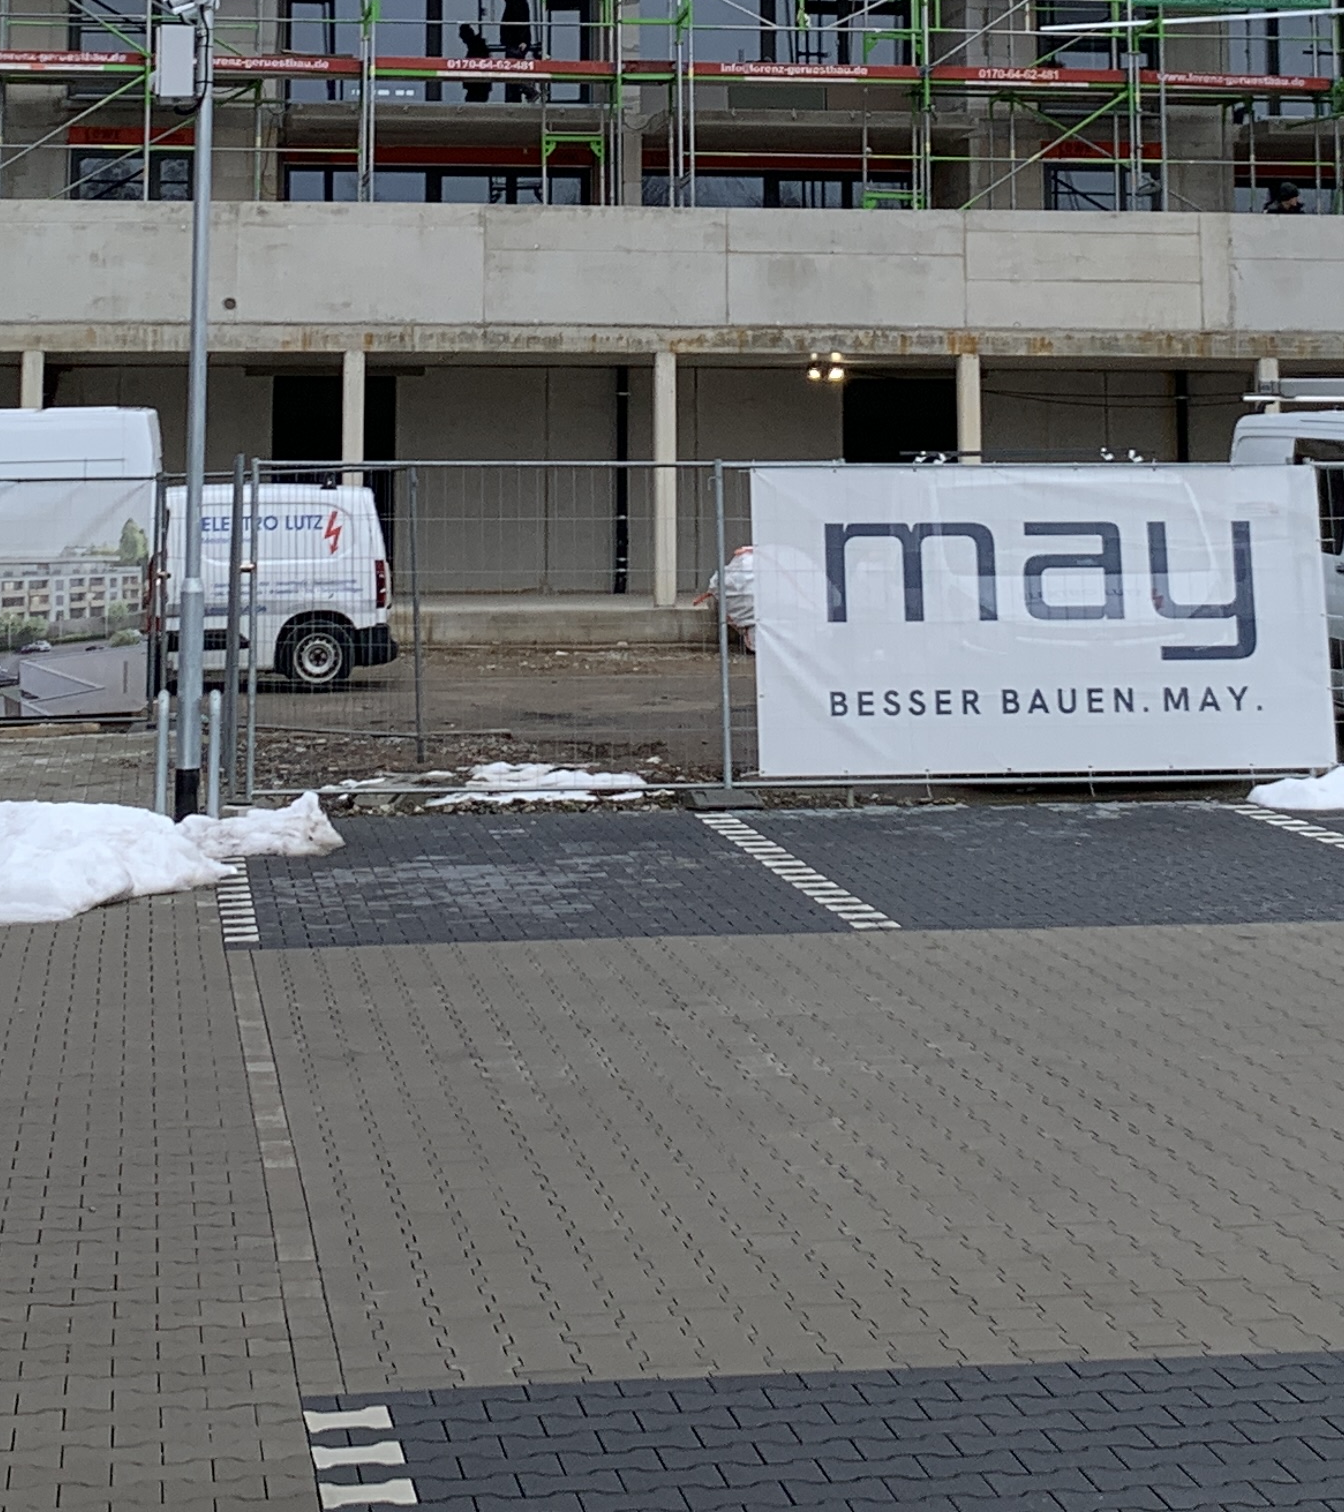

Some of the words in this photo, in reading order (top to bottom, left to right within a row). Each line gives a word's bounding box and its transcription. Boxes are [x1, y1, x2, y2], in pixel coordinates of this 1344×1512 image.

[447, 59, 535, 72] 0170-64-62-481
[720, 63, 868, 76] info@lorenz-geruestbau.de
[978, 69, 1060, 81] 0170-64-62-481
[202, 515, 279, 532] ELETRO
[285, 514, 323, 530] LUTZ
[824, 519, 1258, 661] may
[830, 689, 983, 718] BESSER
[1001, 687, 1150, 717] BAUEN.
[1163, 685, 1265, 713] MAY.
